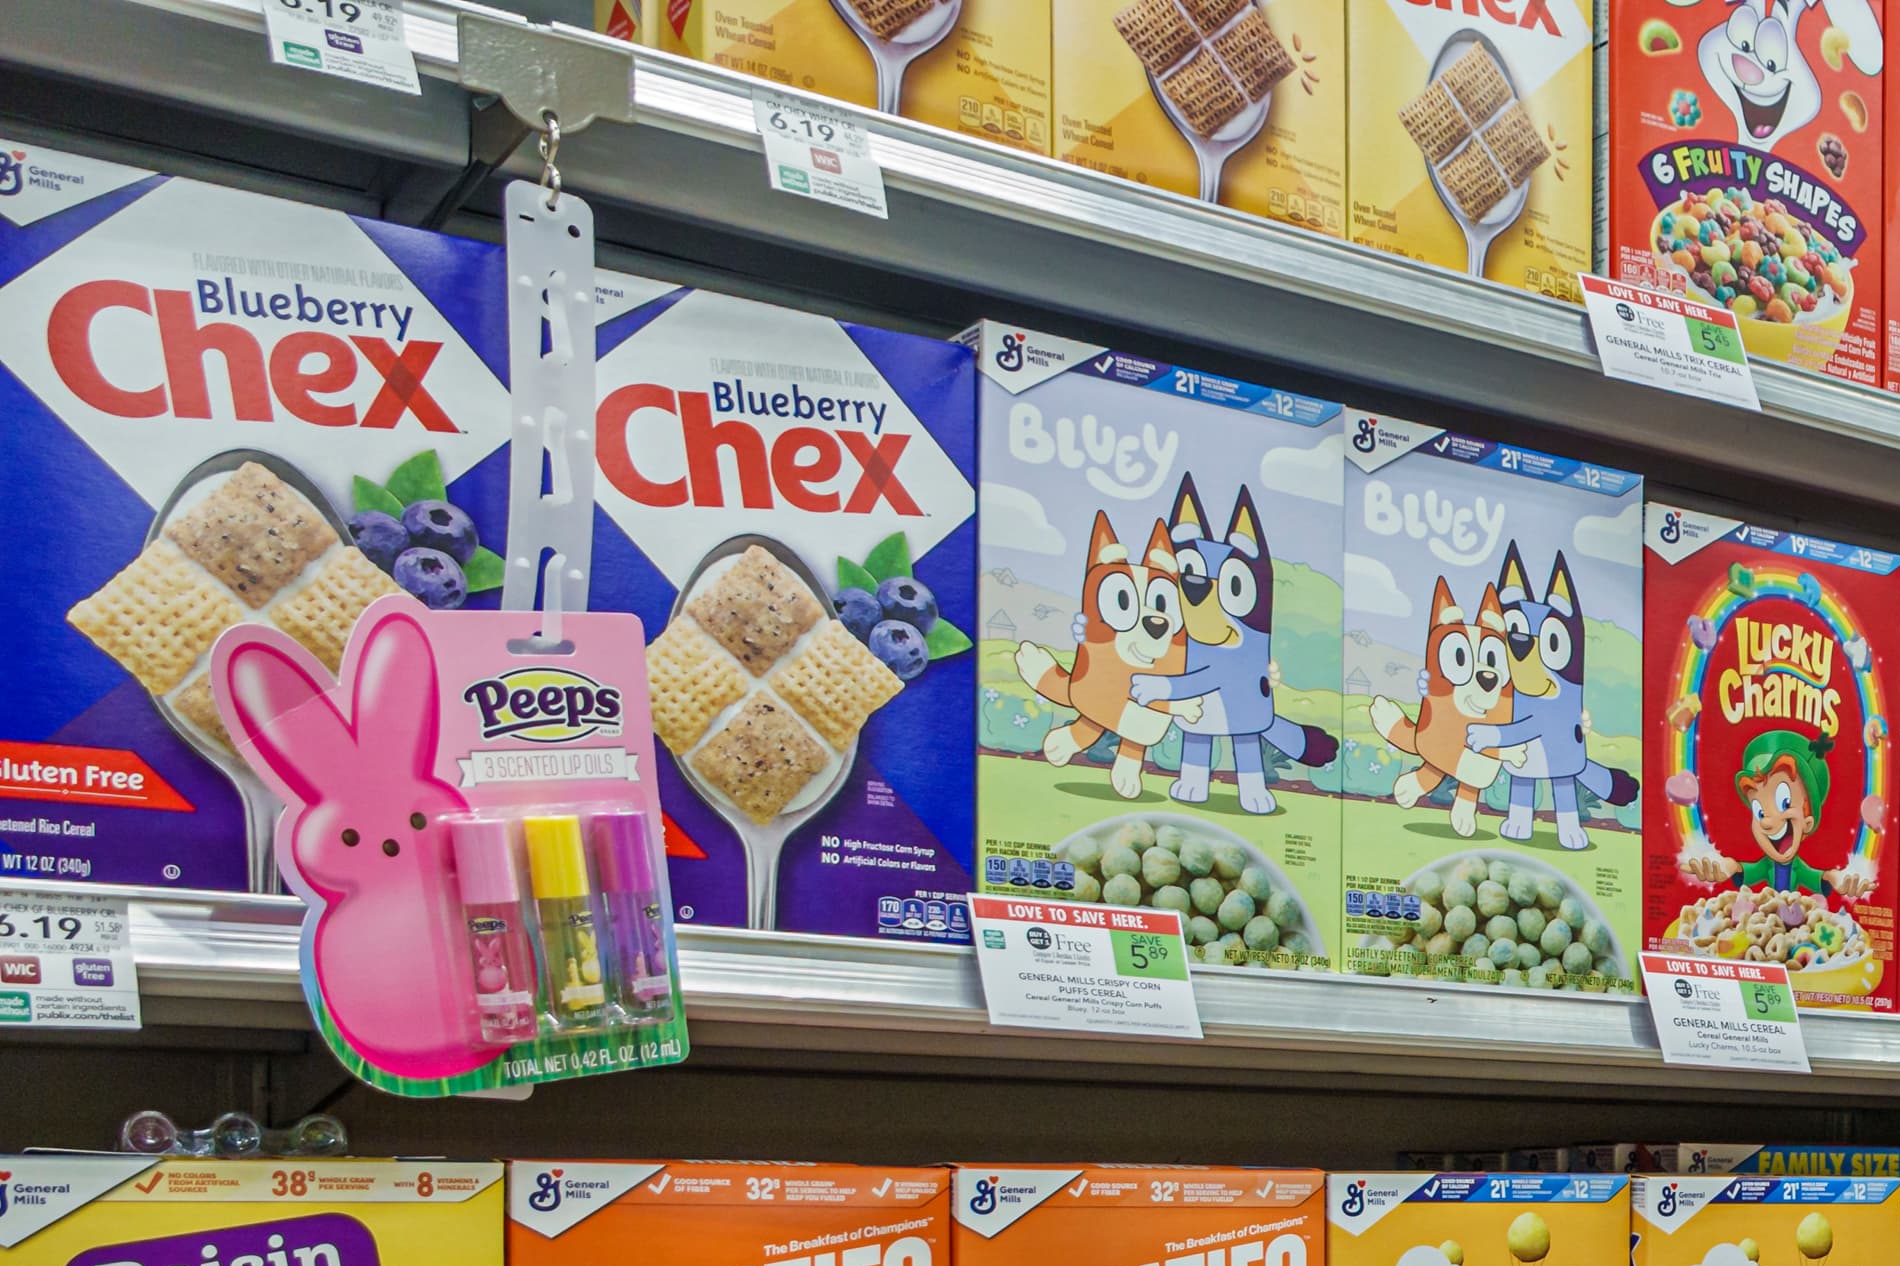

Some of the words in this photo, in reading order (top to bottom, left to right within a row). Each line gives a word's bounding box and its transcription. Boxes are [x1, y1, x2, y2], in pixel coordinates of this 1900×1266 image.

[770, 112, 834, 141] 6.19
[1652, 153, 1675, 185] 6
[1672, 144, 1762, 186] FRUITY
[1766, 165, 1858, 243] SHAPES
[197, 278, 412, 341] Blueberry
[47, 279, 460, 434] Chex
[713, 380, 887, 434] Blueberry
[595, 383, 924, 517] Chex
[1735, 617, 1834, 687] Lucky
[464, 679, 623, 737] Peeps
[1719, 671, 1841, 737] Charms
[84, 763, 145, 792] Free
[486, 757, 494, 778] 3
[497, 756, 560, 778] SCENTED
[563, 756, 582, 775] LIP
[586, 754, 614, 775] OILS
[821, 835, 840, 848] NO
[844, 839, 861, 851] High
[863, 841, 894, 852] Fructose
[895, 844, 913, 854] Corn
[913, 846, 935, 858] Syrup
[3, 853, 23, 870] WT
[26, 856, 38, 871] 12
[41, 856, 55, 872] OZ
[58, 857, 92, 877] (340g)
[1008, 904, 1044, 921] LOVE
[1049, 908, 1066, 922] TO
[1073, 910, 1106, 926] SAVE
[1112, 913, 1148, 929] HERE.
[1055, 933, 1092, 953] Free
[4, 962, 36, 976] WIC
[75, 962, 110, 973] gluten
[83, 972, 105, 981] free
[1018, 973, 1066, 984] GENERAL
[1068, 977, 1095, 986] MILLS
[1098, 979, 1130, 990] CRISPY
[1134, 981, 1161, 991] CORN
[1059, 986, 1089, 996] PUFFS
[1091, 988, 1128, 999] CEREAL
[37, 1012, 135, 1021] publix.com/thelist
[504, 1059, 542, 1079] TOTAL
[545, 1053, 568, 1073] NET
[571, 1051, 598, 1070] 0.42
[600, 1050, 617, 1066] FL.
[619, 1045, 639, 1063] OZ.
[640, 1042, 659, 1062] (12
[659, 1039, 682, 1057] mL)
[14, 1183, 70, 1196] General
[14, 1194, 46, 1206] Mills
[764, 1243, 788, 1257] The
[790, 1233, 849, 1254] Breakfast
[849, 1229, 863, 1242] of
